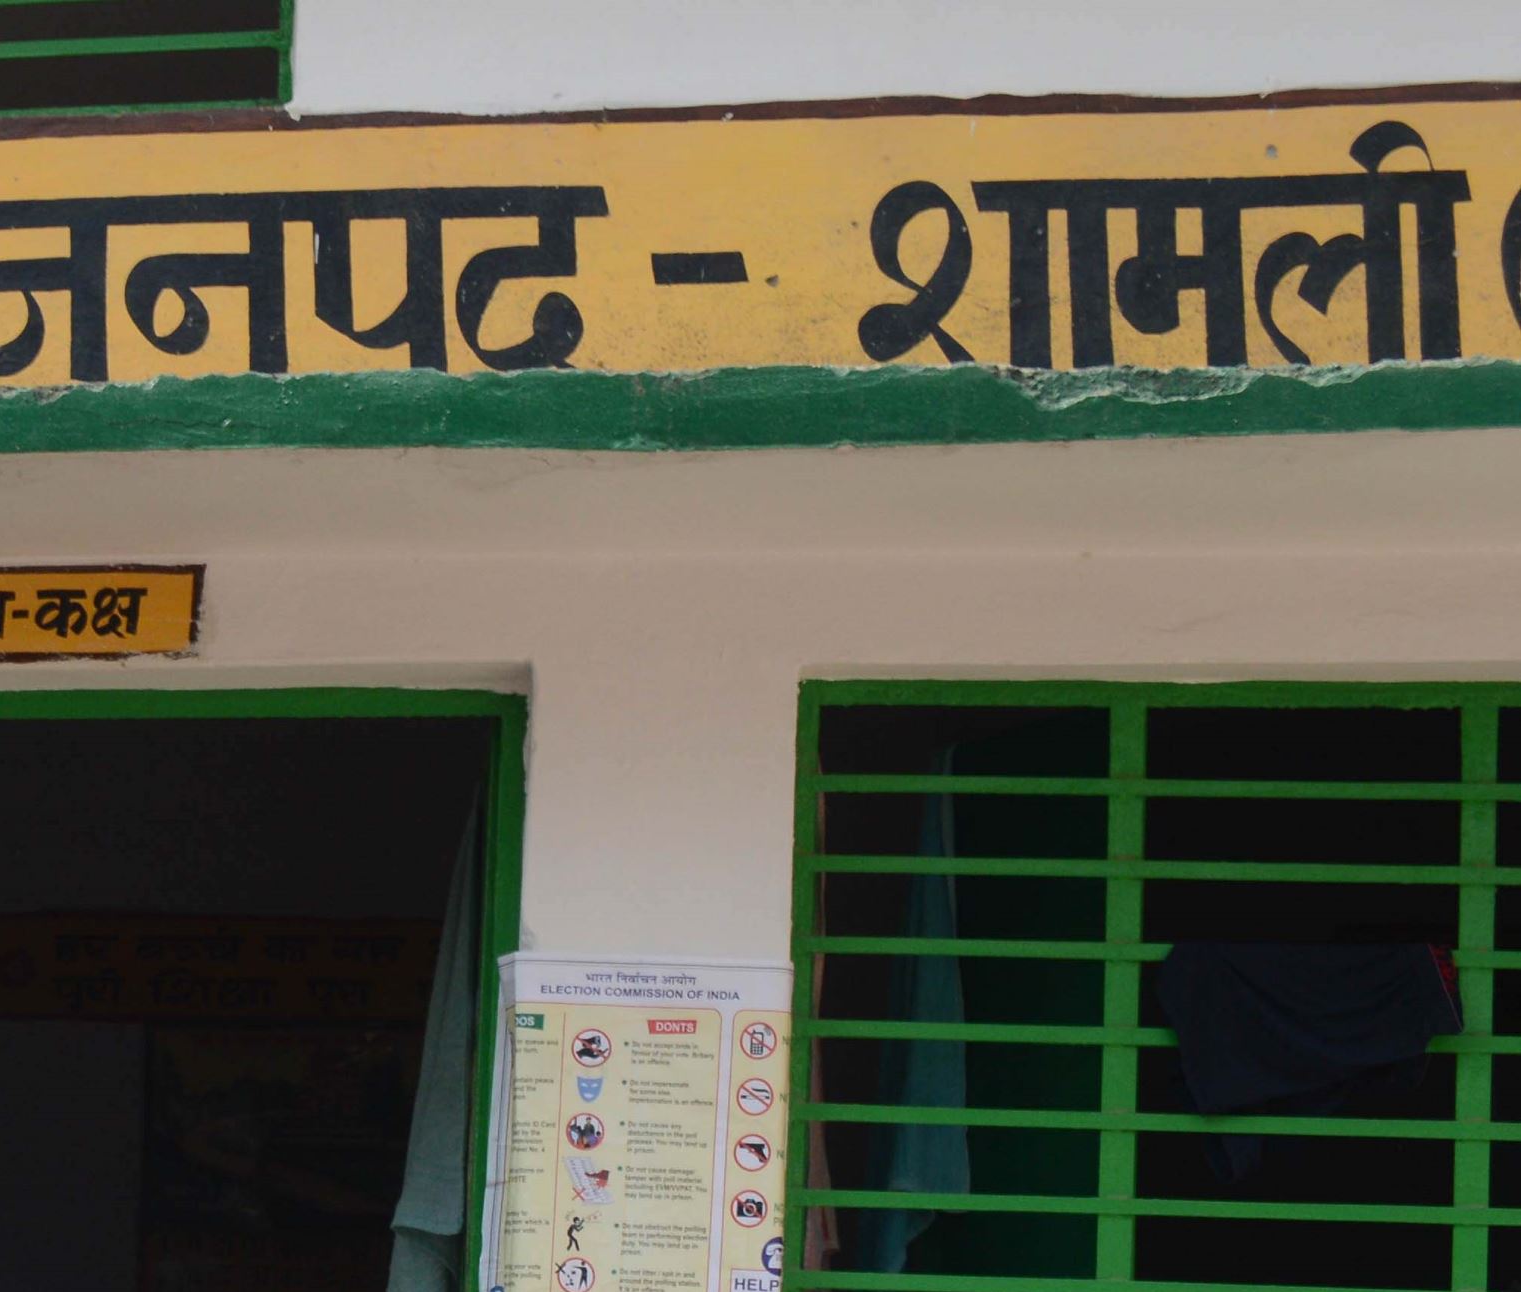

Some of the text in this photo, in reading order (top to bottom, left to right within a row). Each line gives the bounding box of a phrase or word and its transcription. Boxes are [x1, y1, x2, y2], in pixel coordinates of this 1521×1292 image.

[857, 120, 1472, 370] शामली
[586, 972, 697, 987] भारत निर्वाचन आयोग
[541, 984, 740, 1001] ELECTION COMMISSION OF INDIA
[655, 1021, 695, 1033] DONTS
